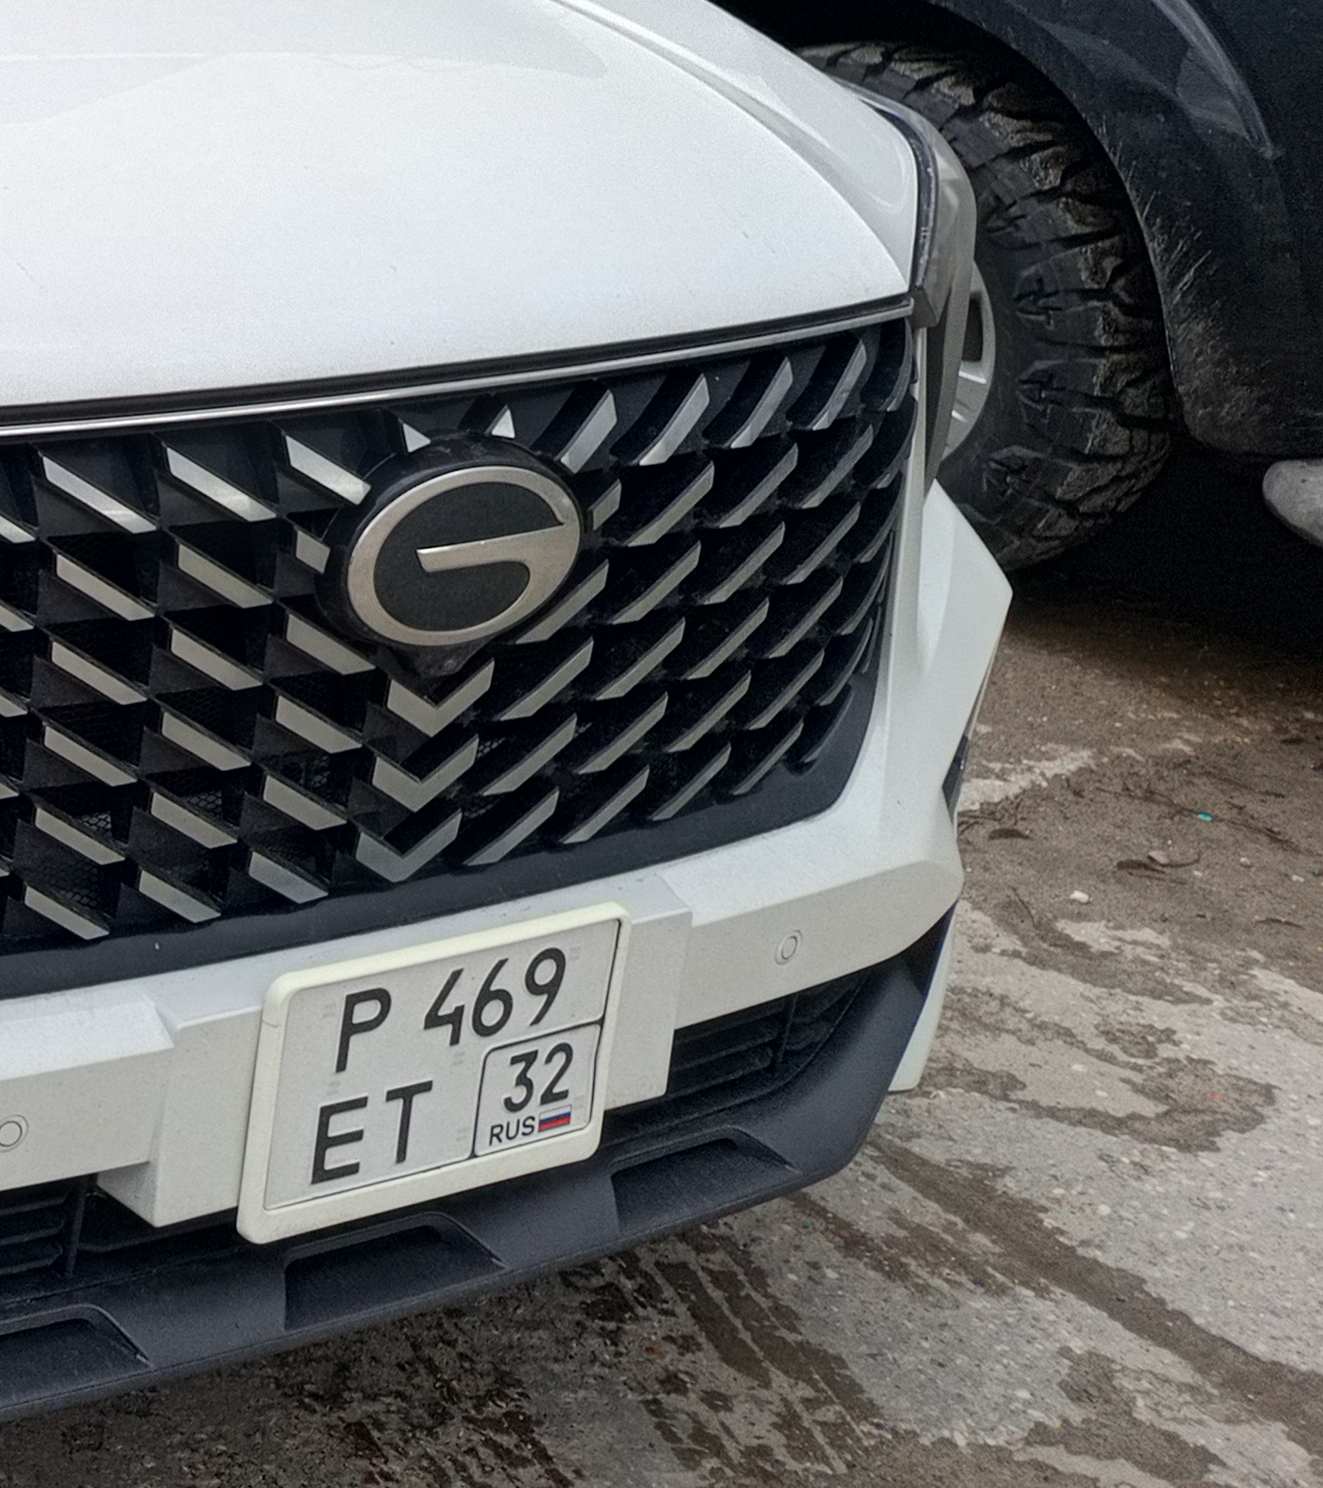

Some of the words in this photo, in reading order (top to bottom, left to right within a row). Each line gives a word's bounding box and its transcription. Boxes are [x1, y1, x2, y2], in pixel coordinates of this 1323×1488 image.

[423, 946, 567, 1047] 469
[502, 1041, 575, 1114] 32
[488, 1115, 536, 1146] RUS
